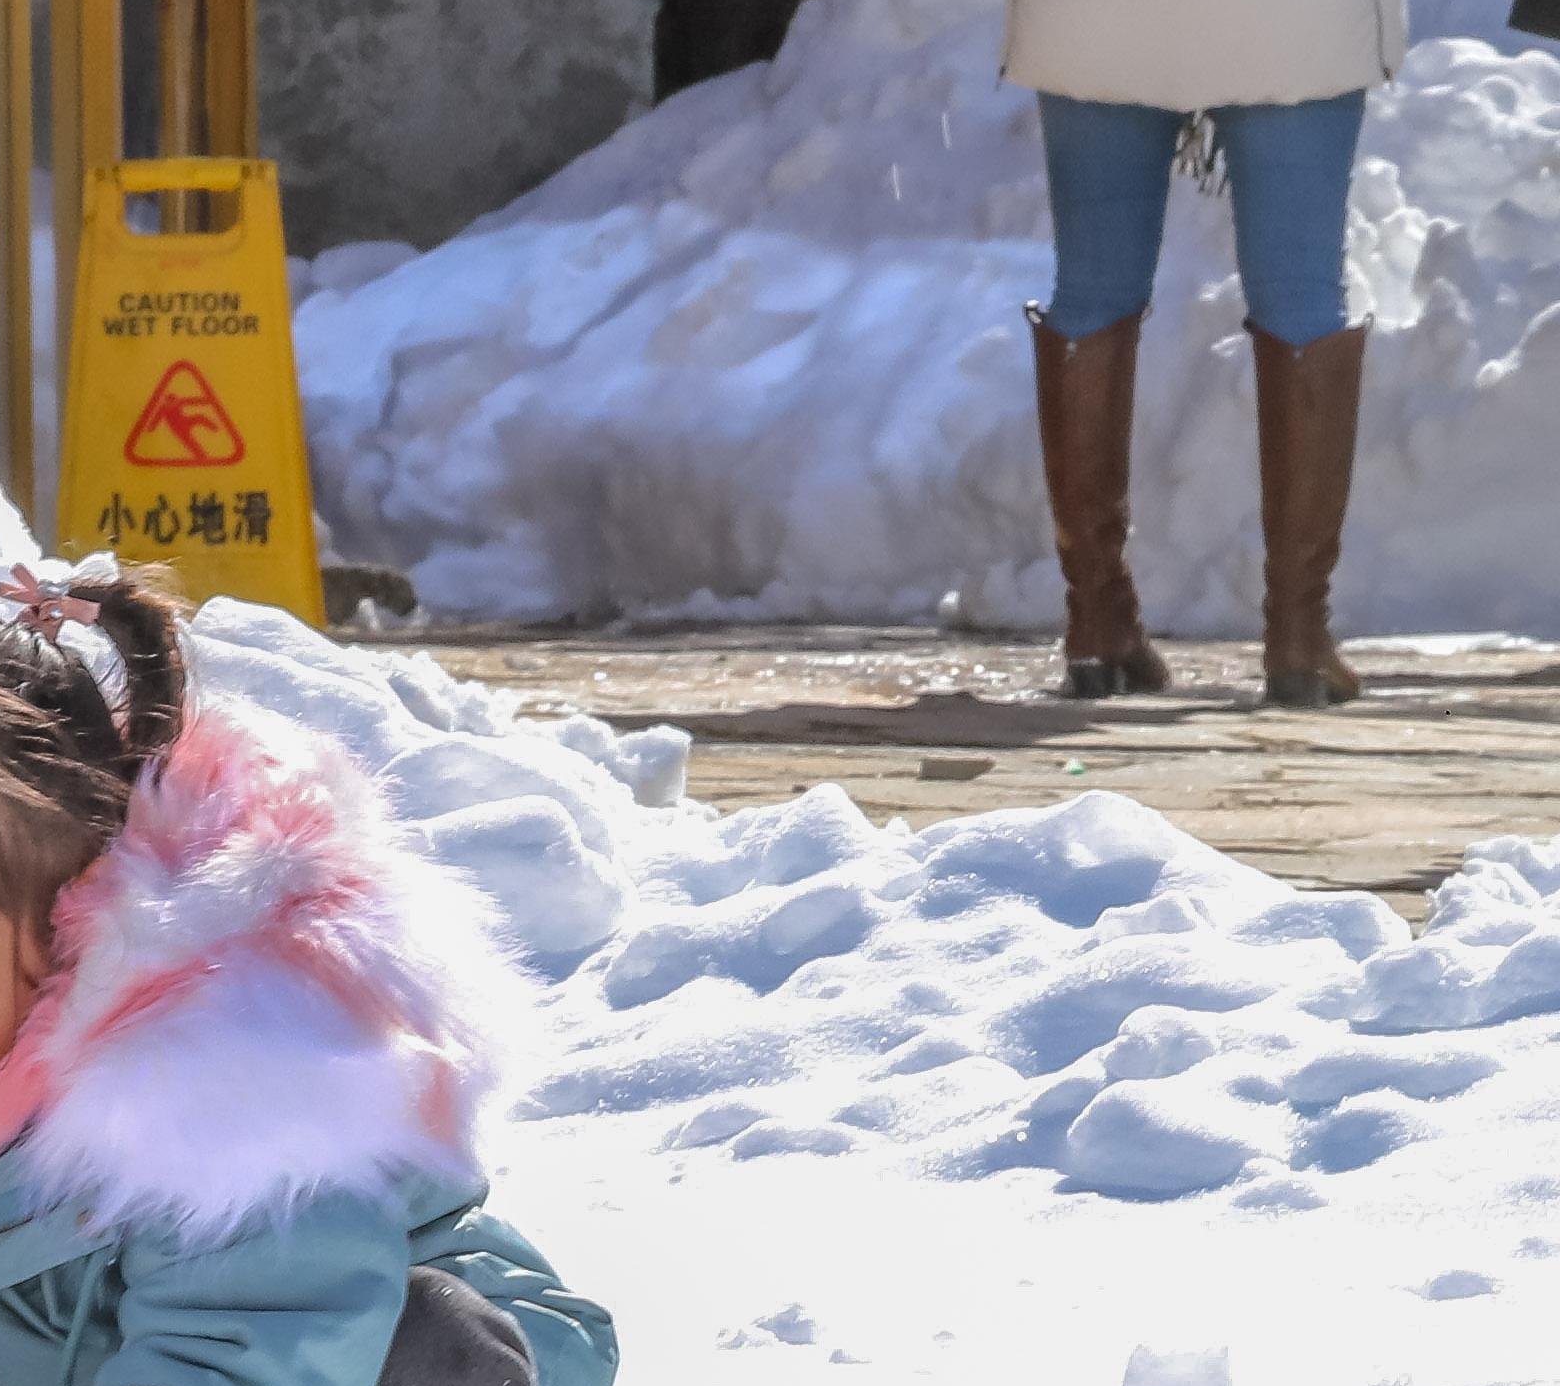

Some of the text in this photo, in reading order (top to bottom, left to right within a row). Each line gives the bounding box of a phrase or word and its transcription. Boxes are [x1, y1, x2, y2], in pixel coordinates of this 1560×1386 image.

[119, 292, 241, 313] CAUTION
[103, 315, 260, 336] WET FLOOR
[97, 489, 272, 546] 小心地滑
